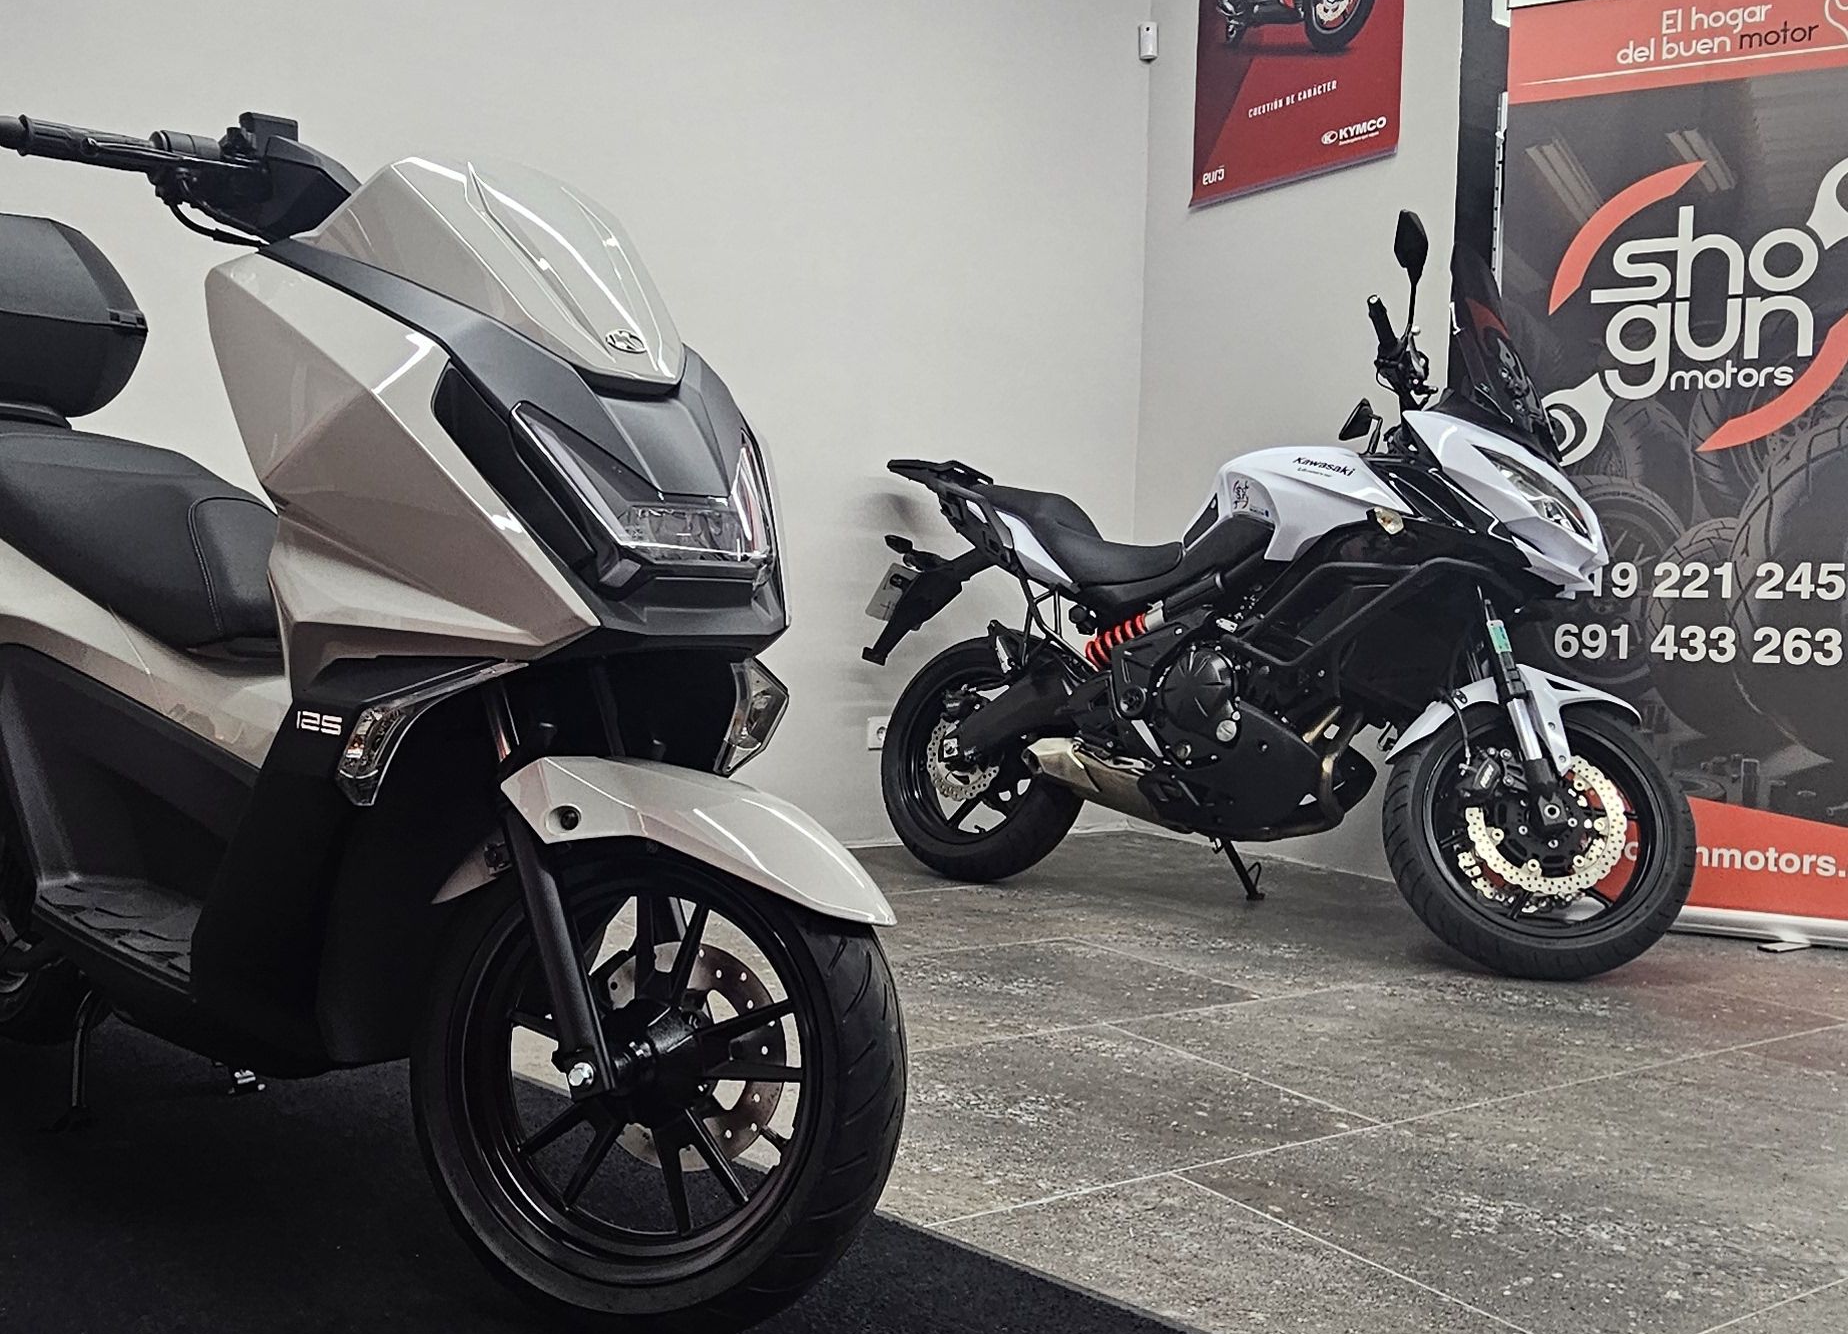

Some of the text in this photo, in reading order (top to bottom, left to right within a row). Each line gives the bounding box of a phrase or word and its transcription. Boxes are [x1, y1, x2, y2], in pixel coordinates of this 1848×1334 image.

[1661, 3, 1772, 34] El hogar
[1616, 20, 1819, 64] del buen motor
[1285, 93, 1296, 106] DE
[1339, 116, 1387, 140] KYMCO
[1669, 359, 1794, 392] motors
[1292, 456, 1356, 477] Kawasaki
[1587, 561, 1847, 601] 19 221 245
[1553, 623, 1844, 667] 691 433 263
[295, 710, 343, 736] 125
